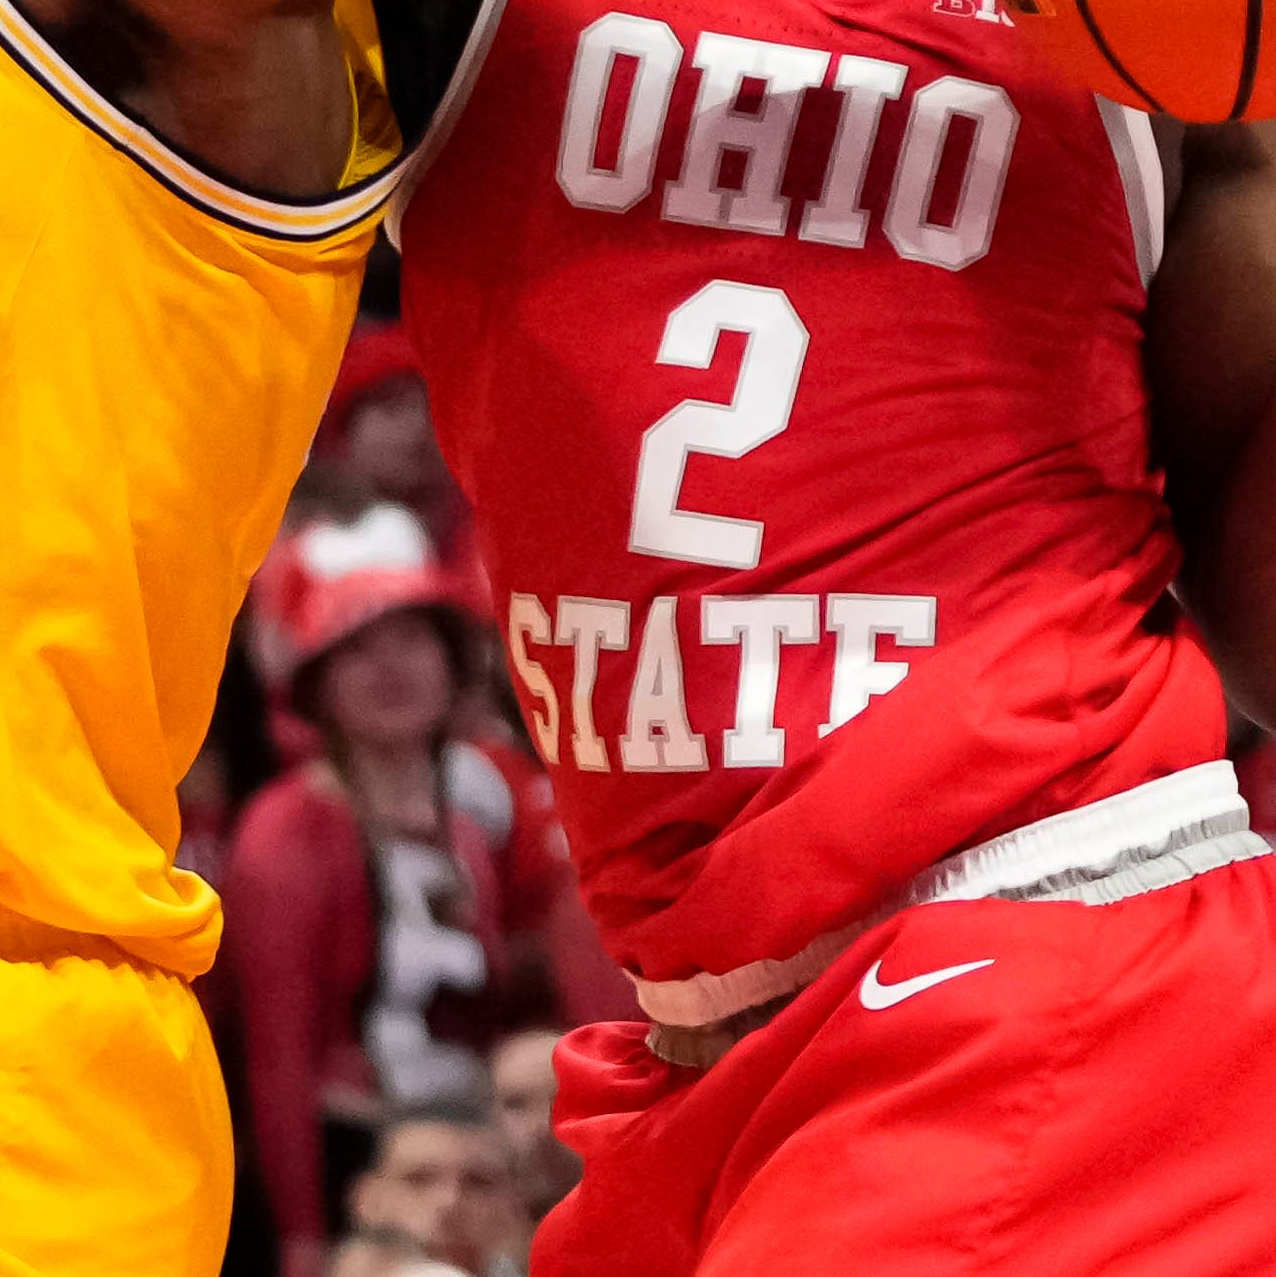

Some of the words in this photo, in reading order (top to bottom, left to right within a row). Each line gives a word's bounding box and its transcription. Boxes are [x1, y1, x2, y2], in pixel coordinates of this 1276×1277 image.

[555, 11, 1022, 273] OHIO
[627, 278, 811, 570] 2
[508, 592, 939, 775] STATE
